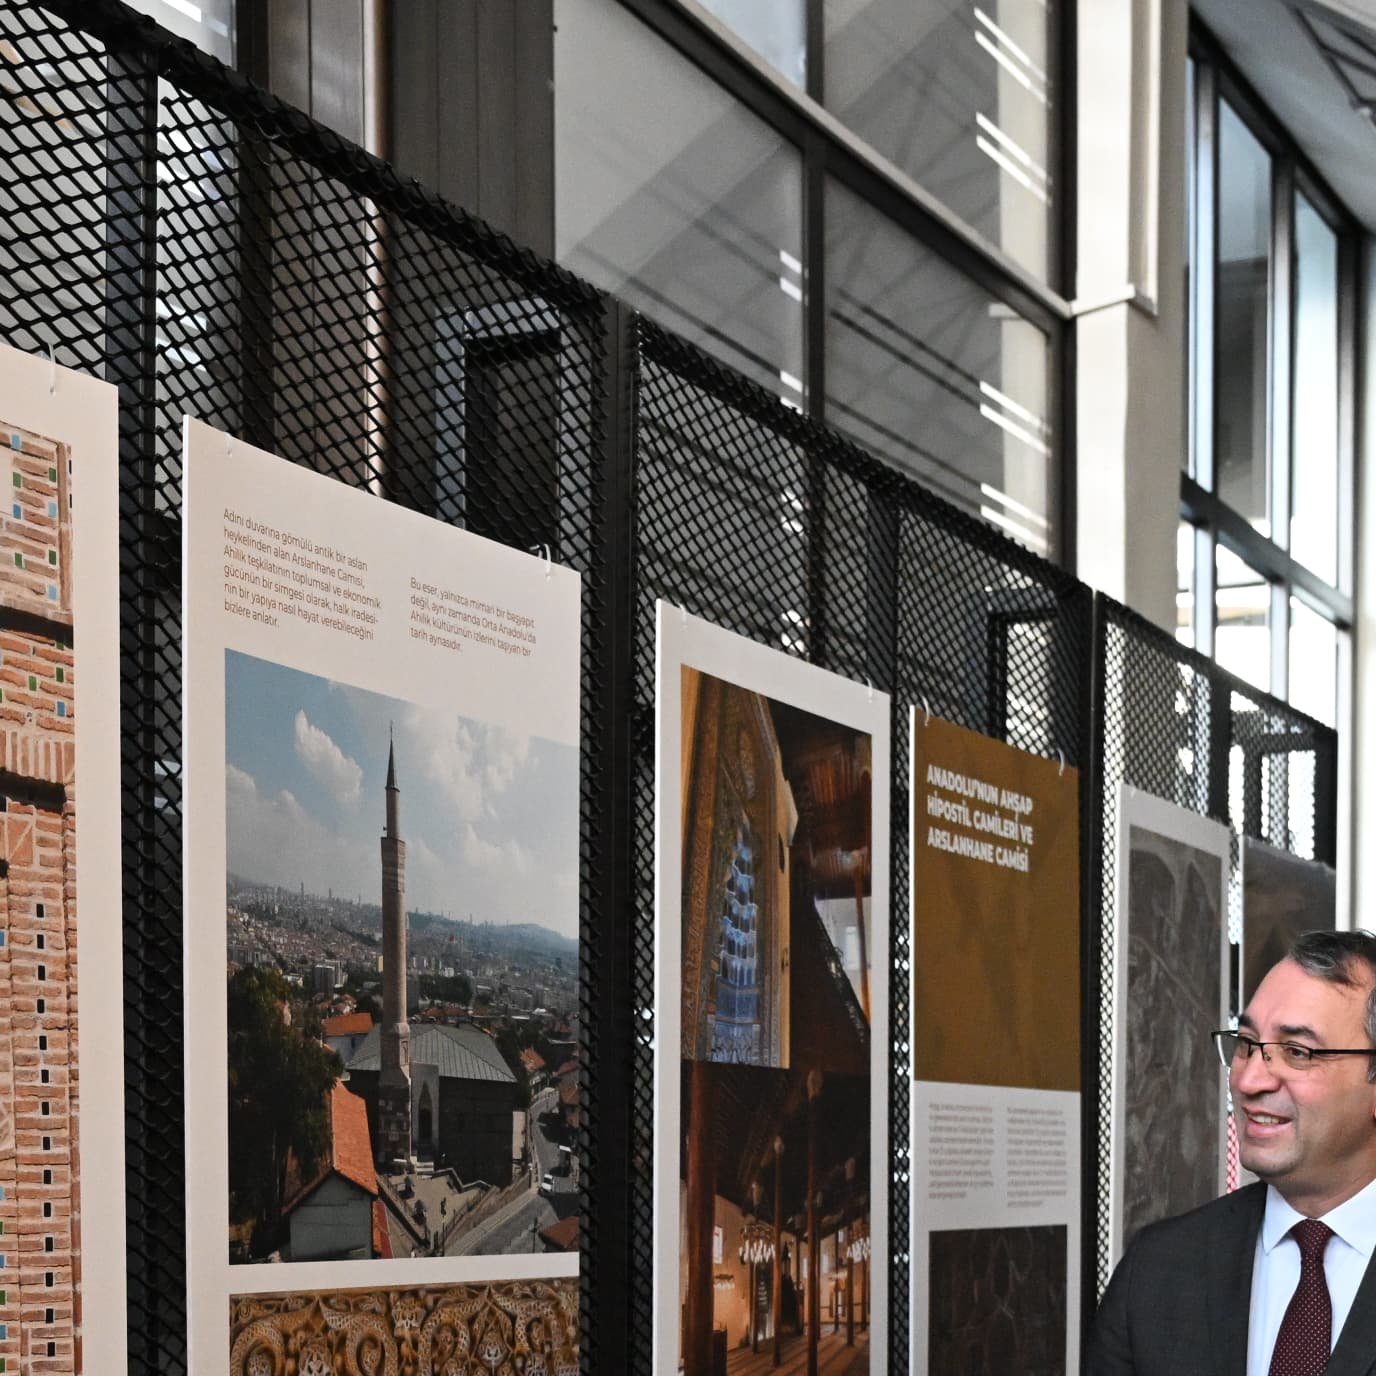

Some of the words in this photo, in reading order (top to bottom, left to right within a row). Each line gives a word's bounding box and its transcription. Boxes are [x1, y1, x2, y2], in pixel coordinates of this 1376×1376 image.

[224, 526, 271, 553] heykelinden
[274, 547, 290, 561] alan
[292, 553, 335, 577] Arslanhane
[314, 544, 334, 559] antik
[336, 551, 346, 563] bir
[348, 556, 367, 571] aslan
[262, 576, 272, 590] bir
[333, 601, 349, 615] halk
[292, 569, 331, 593] toplumsal
[333, 585, 342, 597] ve
[411, 576, 421, 590] Bu
[239, 584, 249, 599] bir
[297, 606, 319, 624] hayat
[481, 617, 497, 631] Orta
[927, 764, 999, 806] ANADOLU'NUN
[927, 790, 971, 828] HİPOSTİL
[973, 808, 1019, 841] CAMİLERİ
[1020, 823, 1034, 845] VE
[927, 826, 994, 863] ARSLANHANE
[995, 845, 1029, 872] CAMİSİ
